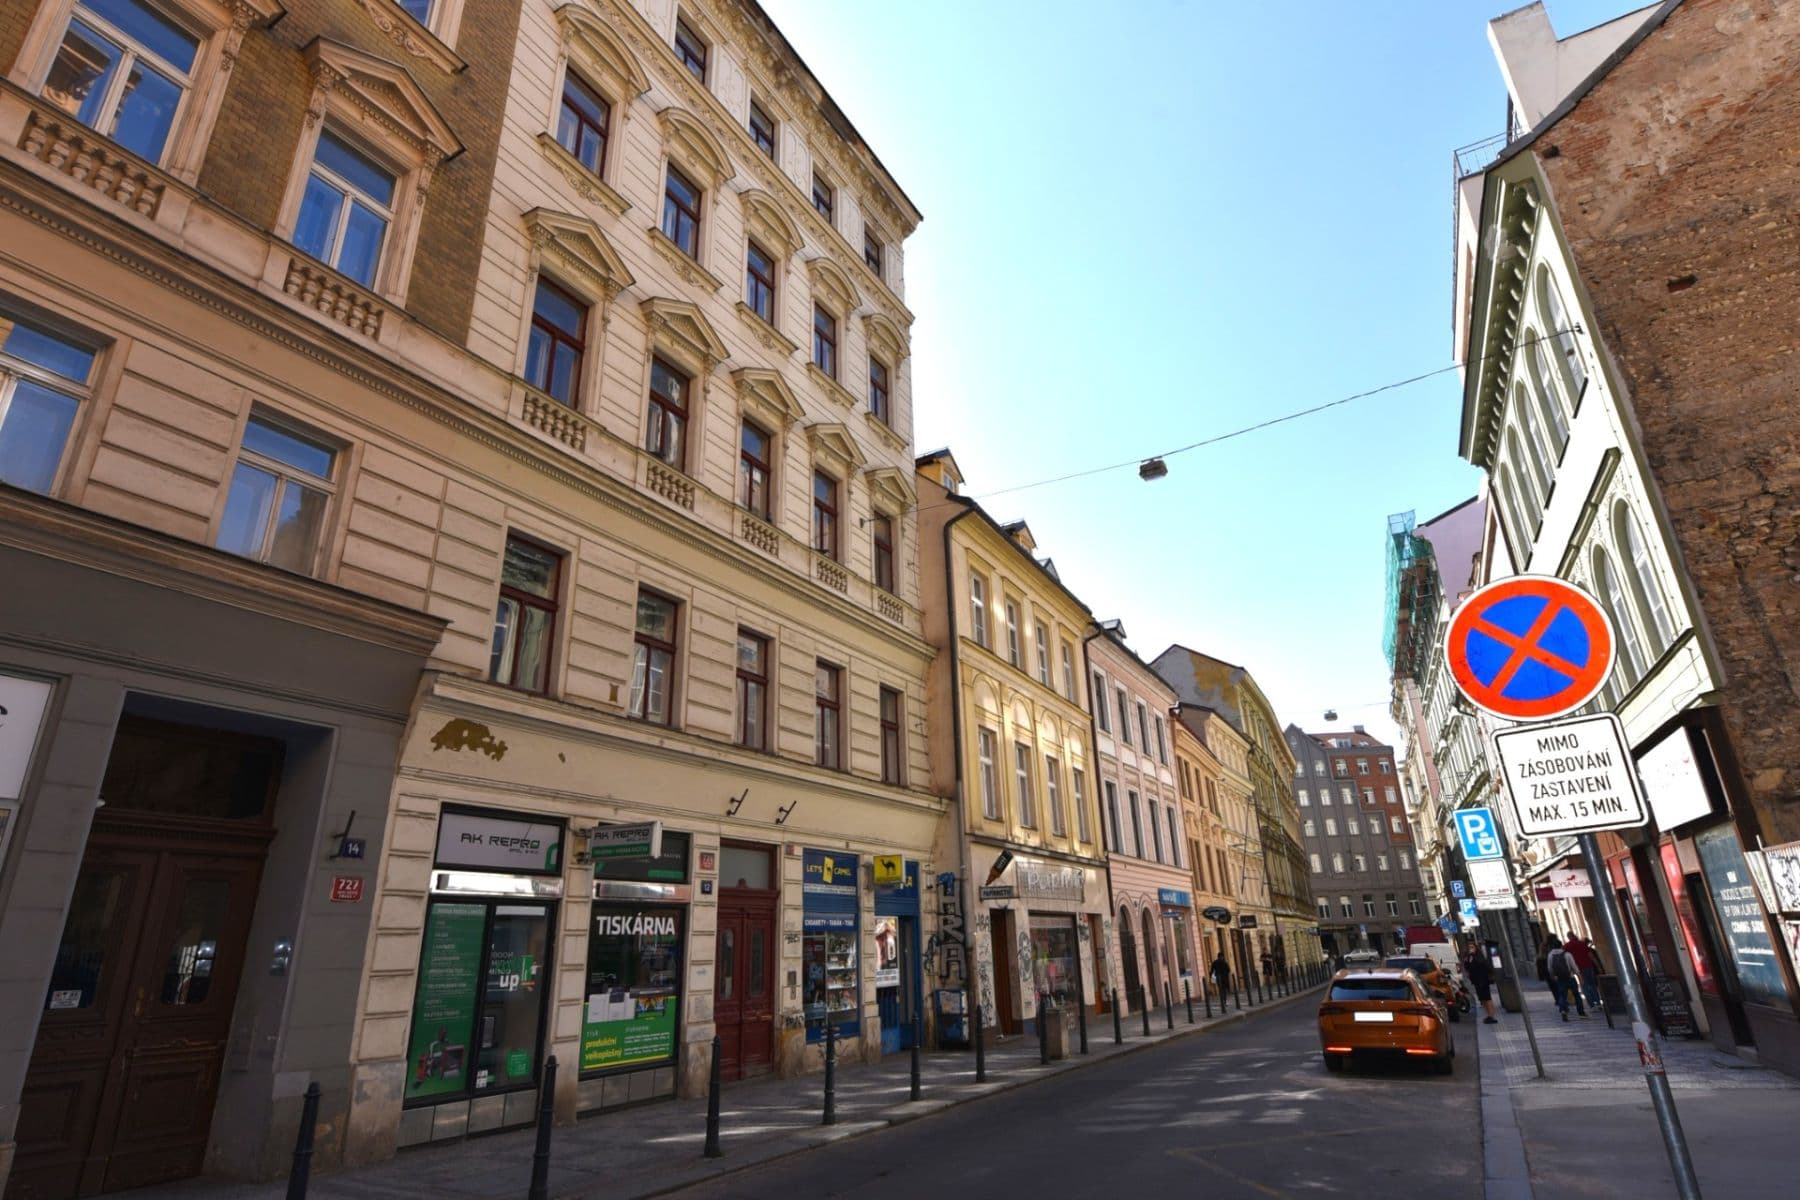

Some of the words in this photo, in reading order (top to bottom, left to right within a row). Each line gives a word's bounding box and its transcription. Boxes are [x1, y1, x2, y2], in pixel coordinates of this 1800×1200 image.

[1537, 733, 1579, 753] MIMO
[1518, 748, 1612, 779] ZÁSOBOVÁNÍ
[1530, 771, 1612, 800] ZASTAVENÍ
[1529, 804, 1567, 822] MAX.
[1570, 801, 1589, 818] 15
[1592, 796, 1628, 815] MIN.
[1462, 814, 1486, 844] P
[348, 842, 359, 854] 14
[460, 832, 483, 844] AK
[488, 836, 540, 849] REPRO
[338, 879, 360, 890] 727
[596, 912, 676, 935] TISKÁRNA
[500, 974, 519, 992] up
